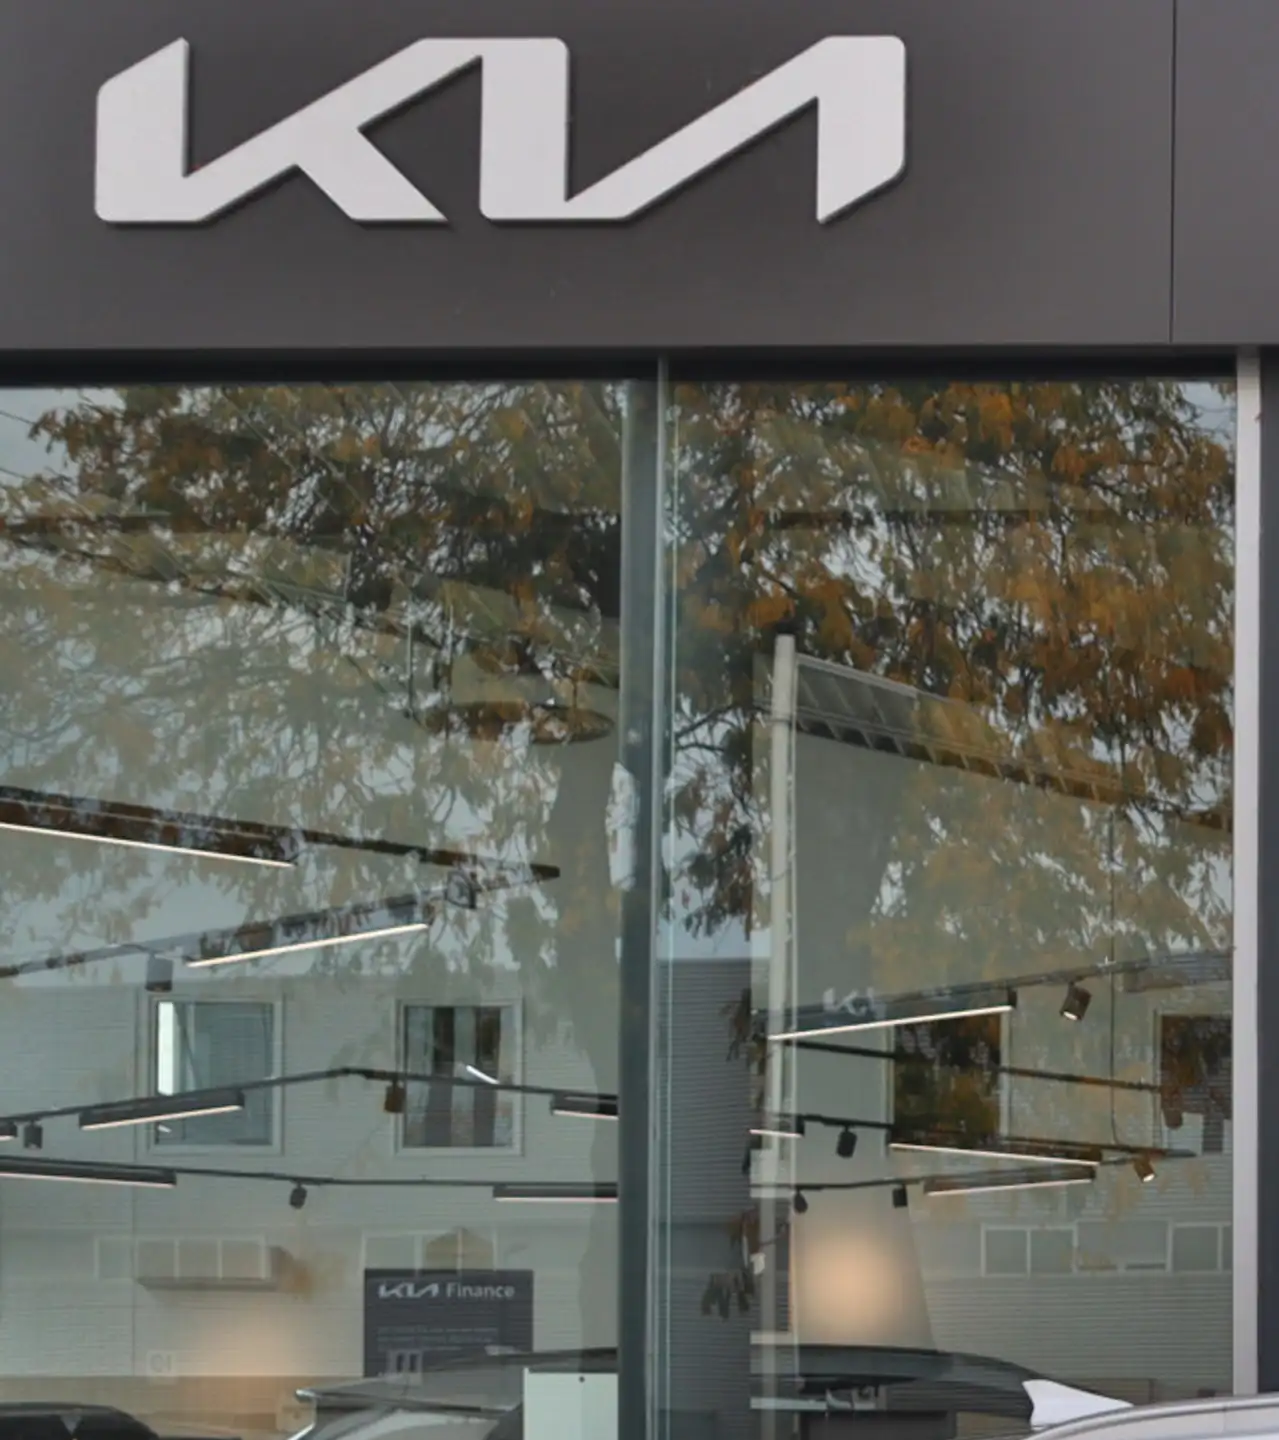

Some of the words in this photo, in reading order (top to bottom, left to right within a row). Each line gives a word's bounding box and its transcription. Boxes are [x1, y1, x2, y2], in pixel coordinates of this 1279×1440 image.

[95, 35, 906, 224] KIA
[379, 1282, 439, 1298] KIA
[445, 1282, 516, 1298] Finance
